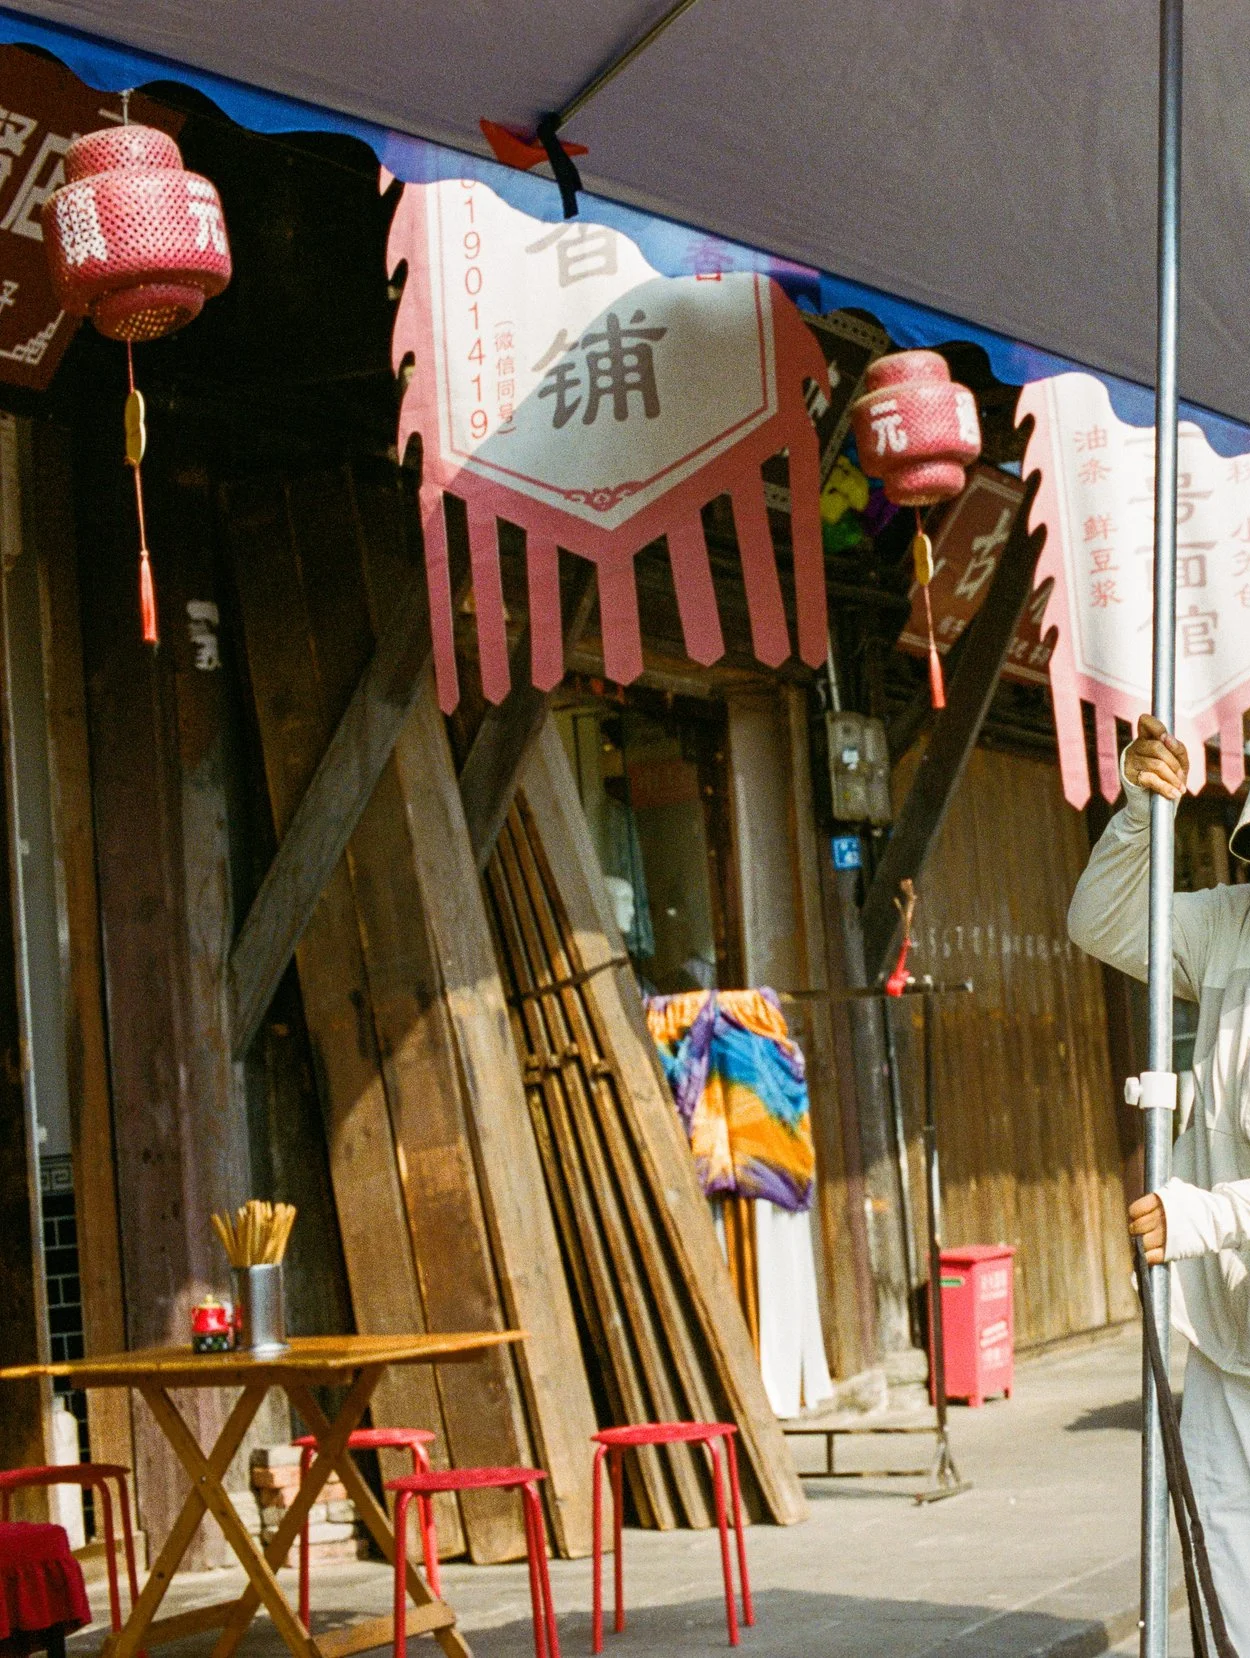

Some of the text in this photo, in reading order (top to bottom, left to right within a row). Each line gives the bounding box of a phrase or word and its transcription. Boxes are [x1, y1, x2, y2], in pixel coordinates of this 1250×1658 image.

[869, 399, 908, 456] 元
[1074, 424, 1122, 609] 油条 鲜豆浆
